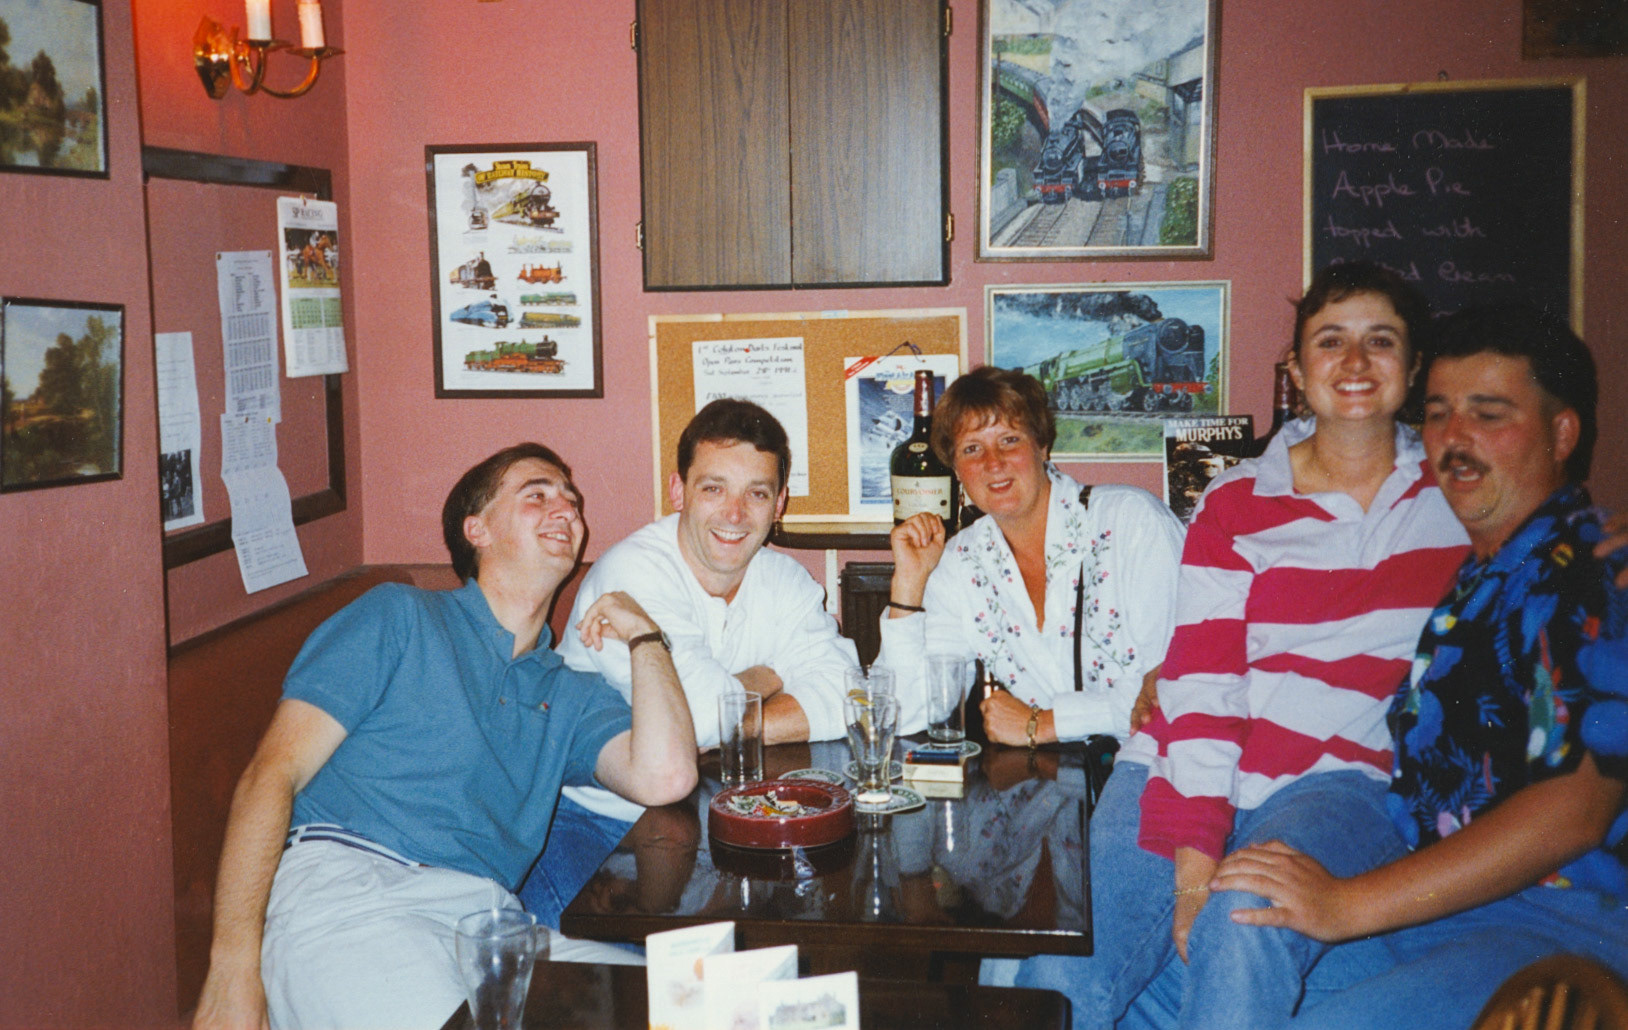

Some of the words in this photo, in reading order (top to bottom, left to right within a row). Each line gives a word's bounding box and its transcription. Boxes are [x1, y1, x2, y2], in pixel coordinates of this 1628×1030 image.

[1322, 128, 1396, 154] Home
[1412, 128, 1496, 150] Made
[1331, 169, 1417, 207] Apple
[1425, 166, 1472, 195] Pie
[1323, 214, 1404, 248] topped
[1421, 216, 1487, 238] with
[702, 357, 720, 368] Open
[745, 354, 793, 365] Competition
[1167, 418, 1198, 428] MAKE
[1199, 418, 1226, 427] TIME
[1228, 417, 1249, 426] FOR
